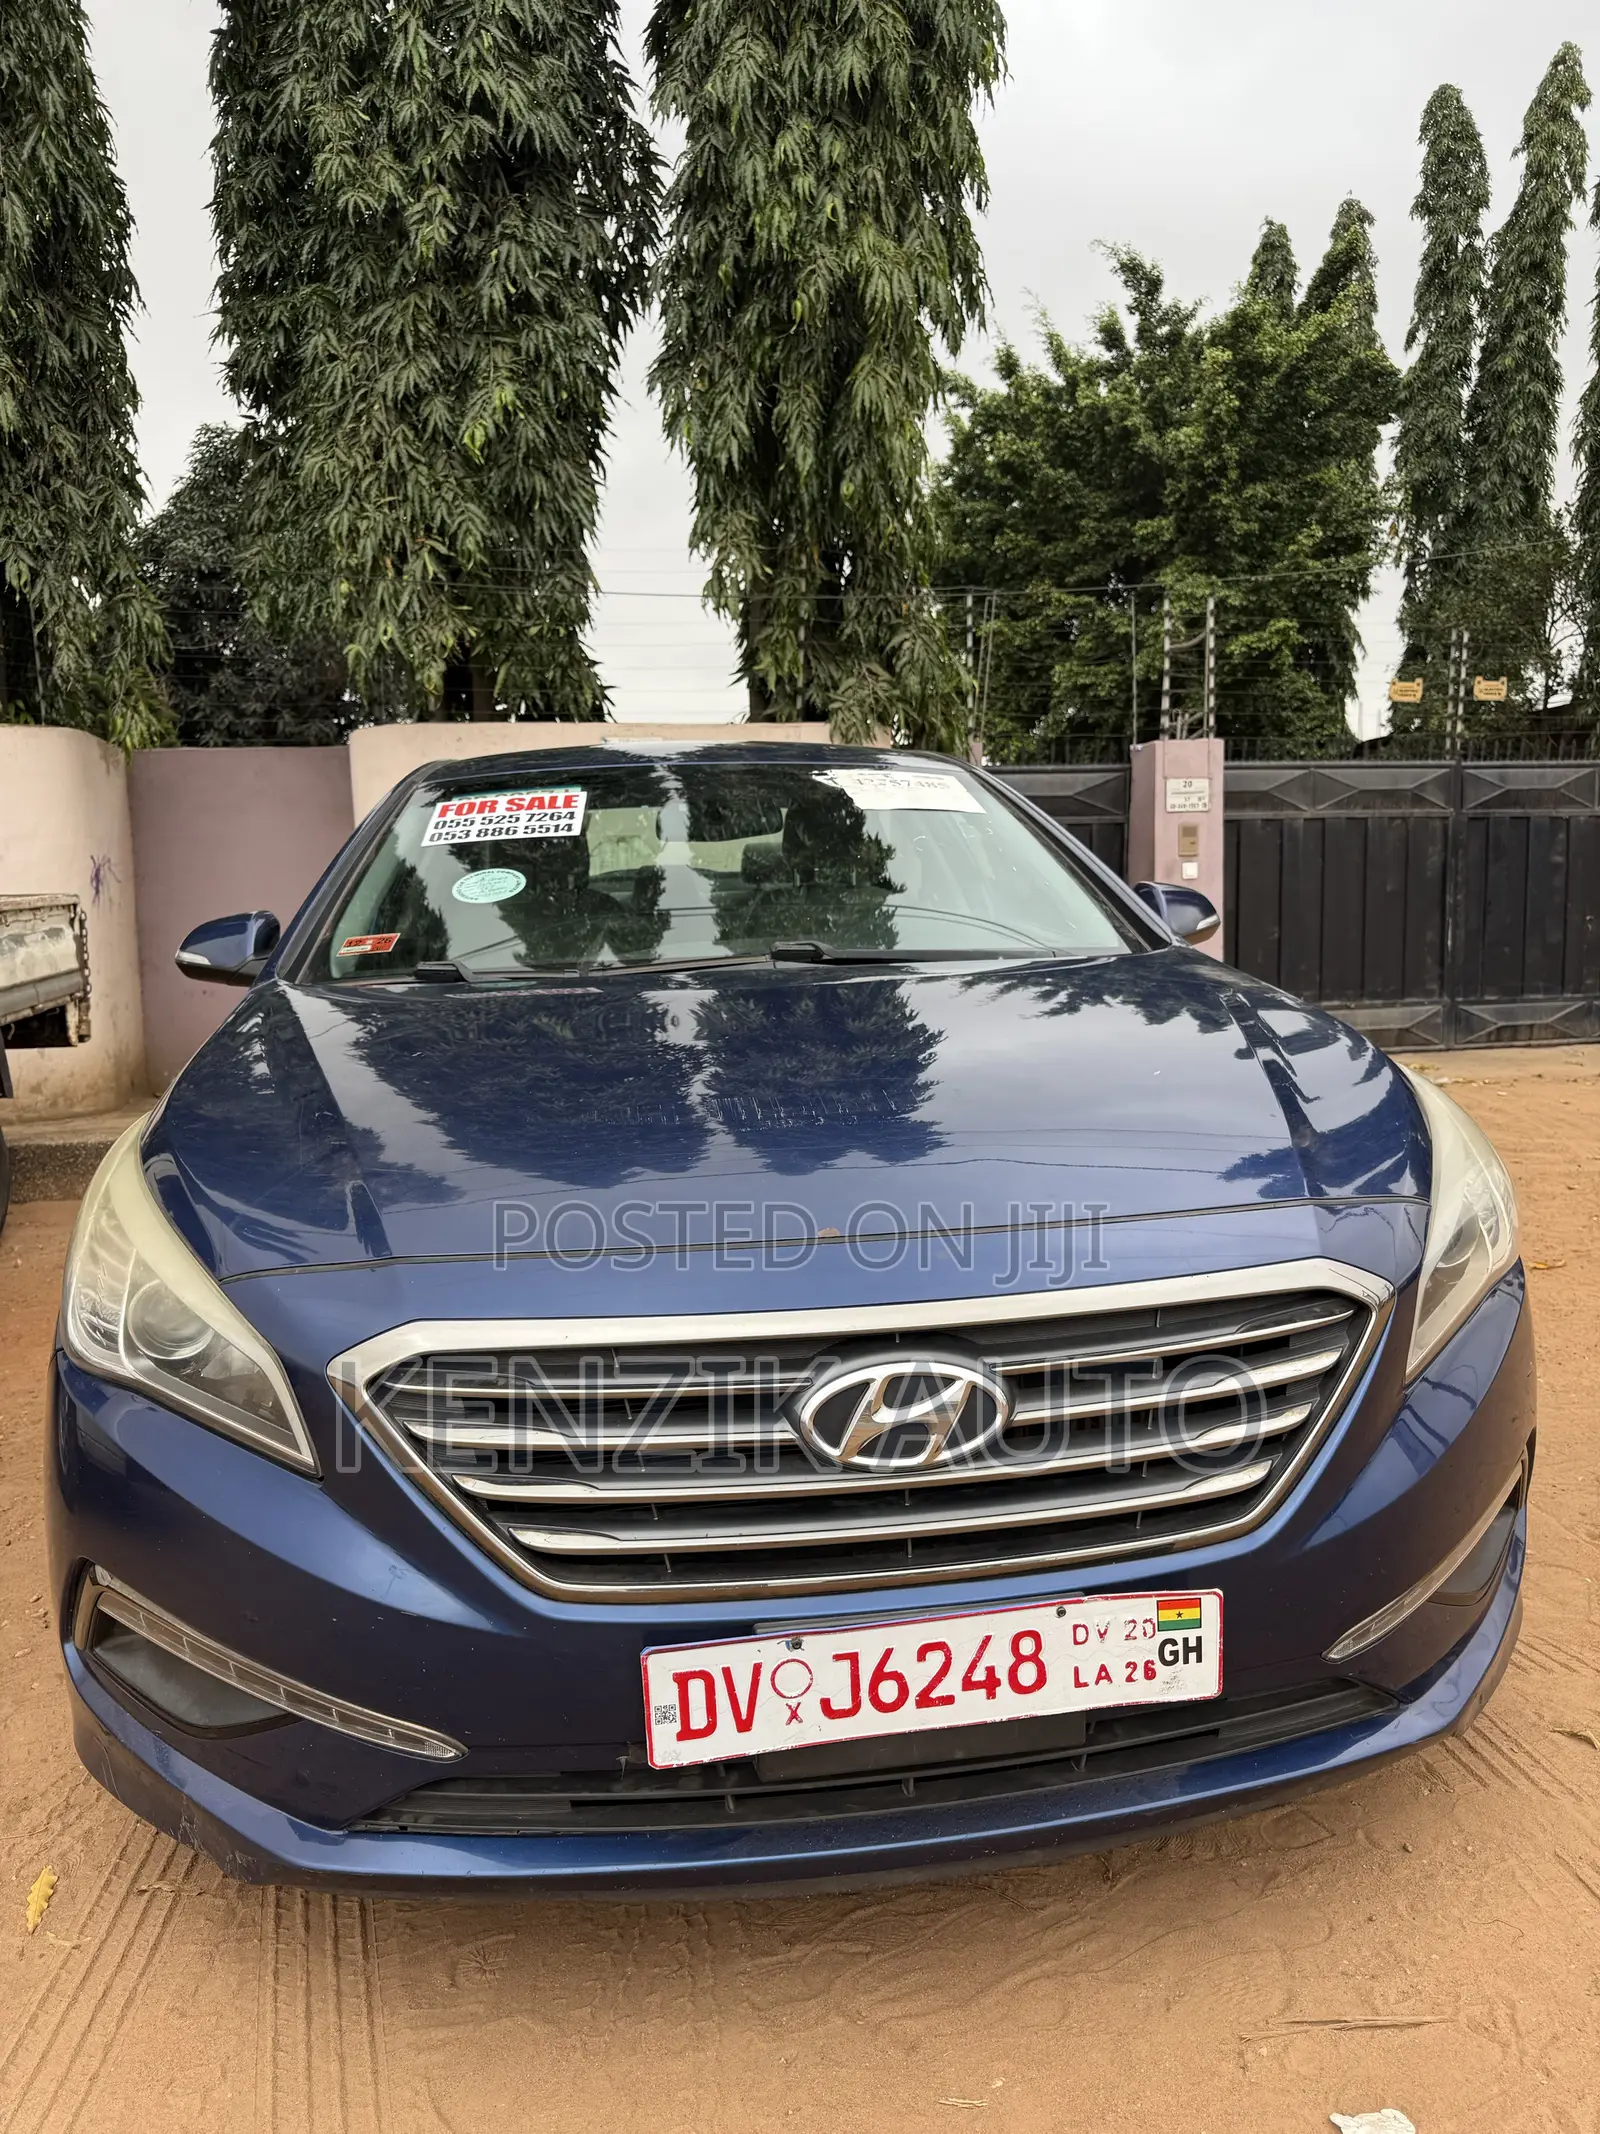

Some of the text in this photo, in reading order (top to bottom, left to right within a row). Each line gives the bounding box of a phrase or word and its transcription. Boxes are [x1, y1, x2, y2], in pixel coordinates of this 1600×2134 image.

[437, 799, 499, 818] FOR
[505, 794, 580, 812] SALE
[429, 823, 574, 842] 053 886 5514
[433, 811, 576, 830] 055 525 7264
[1158, 1635, 1203, 1666] GH
[672, 1661, 762, 1741] DV
[818, 1629, 1048, 1720] J6248
[1073, 1663, 1112, 1688] LA
[1125, 1659, 1157, 1683] 26
